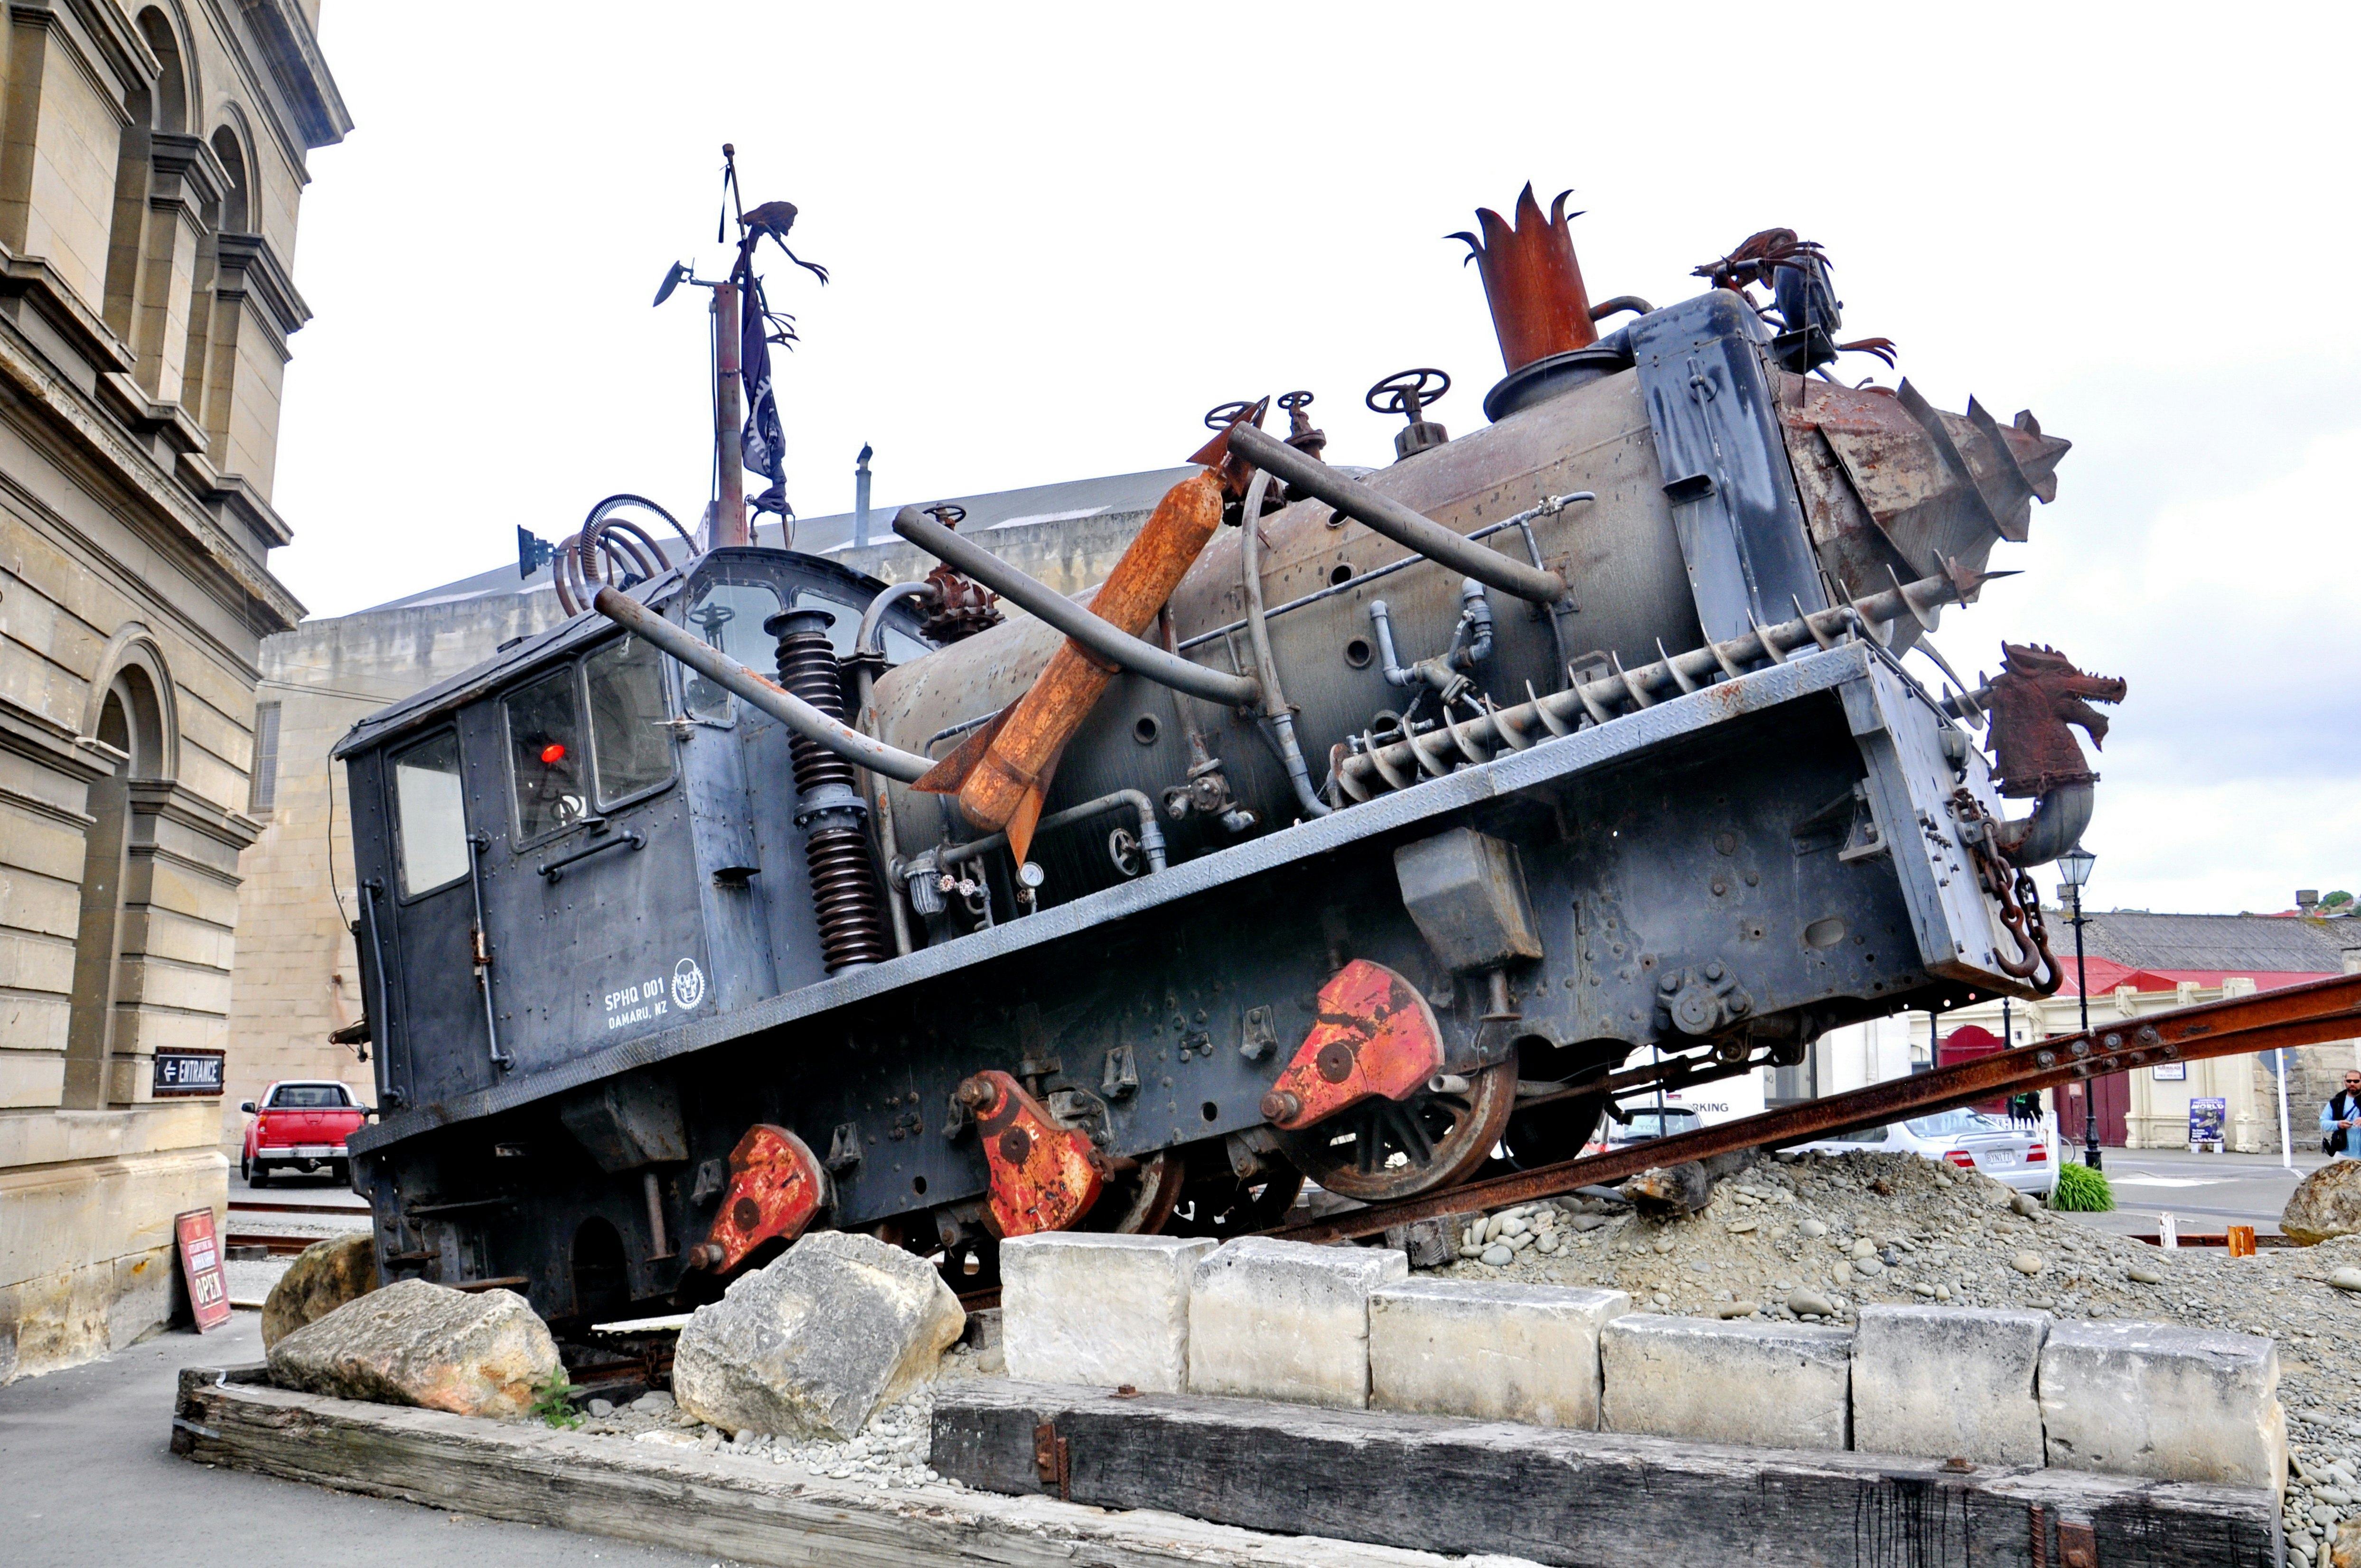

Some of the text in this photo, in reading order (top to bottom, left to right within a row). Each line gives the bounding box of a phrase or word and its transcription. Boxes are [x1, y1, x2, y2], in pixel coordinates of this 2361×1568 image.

[605, 977, 664, 1011] SPHQ 001
[609, 1000, 668, 1029] OAMARU, NZ
[178, 1060, 217, 1083] ENTRANCE
[1692, 1103, 1729, 1112] RKING
[195, 1272, 223, 1304] OPEN
